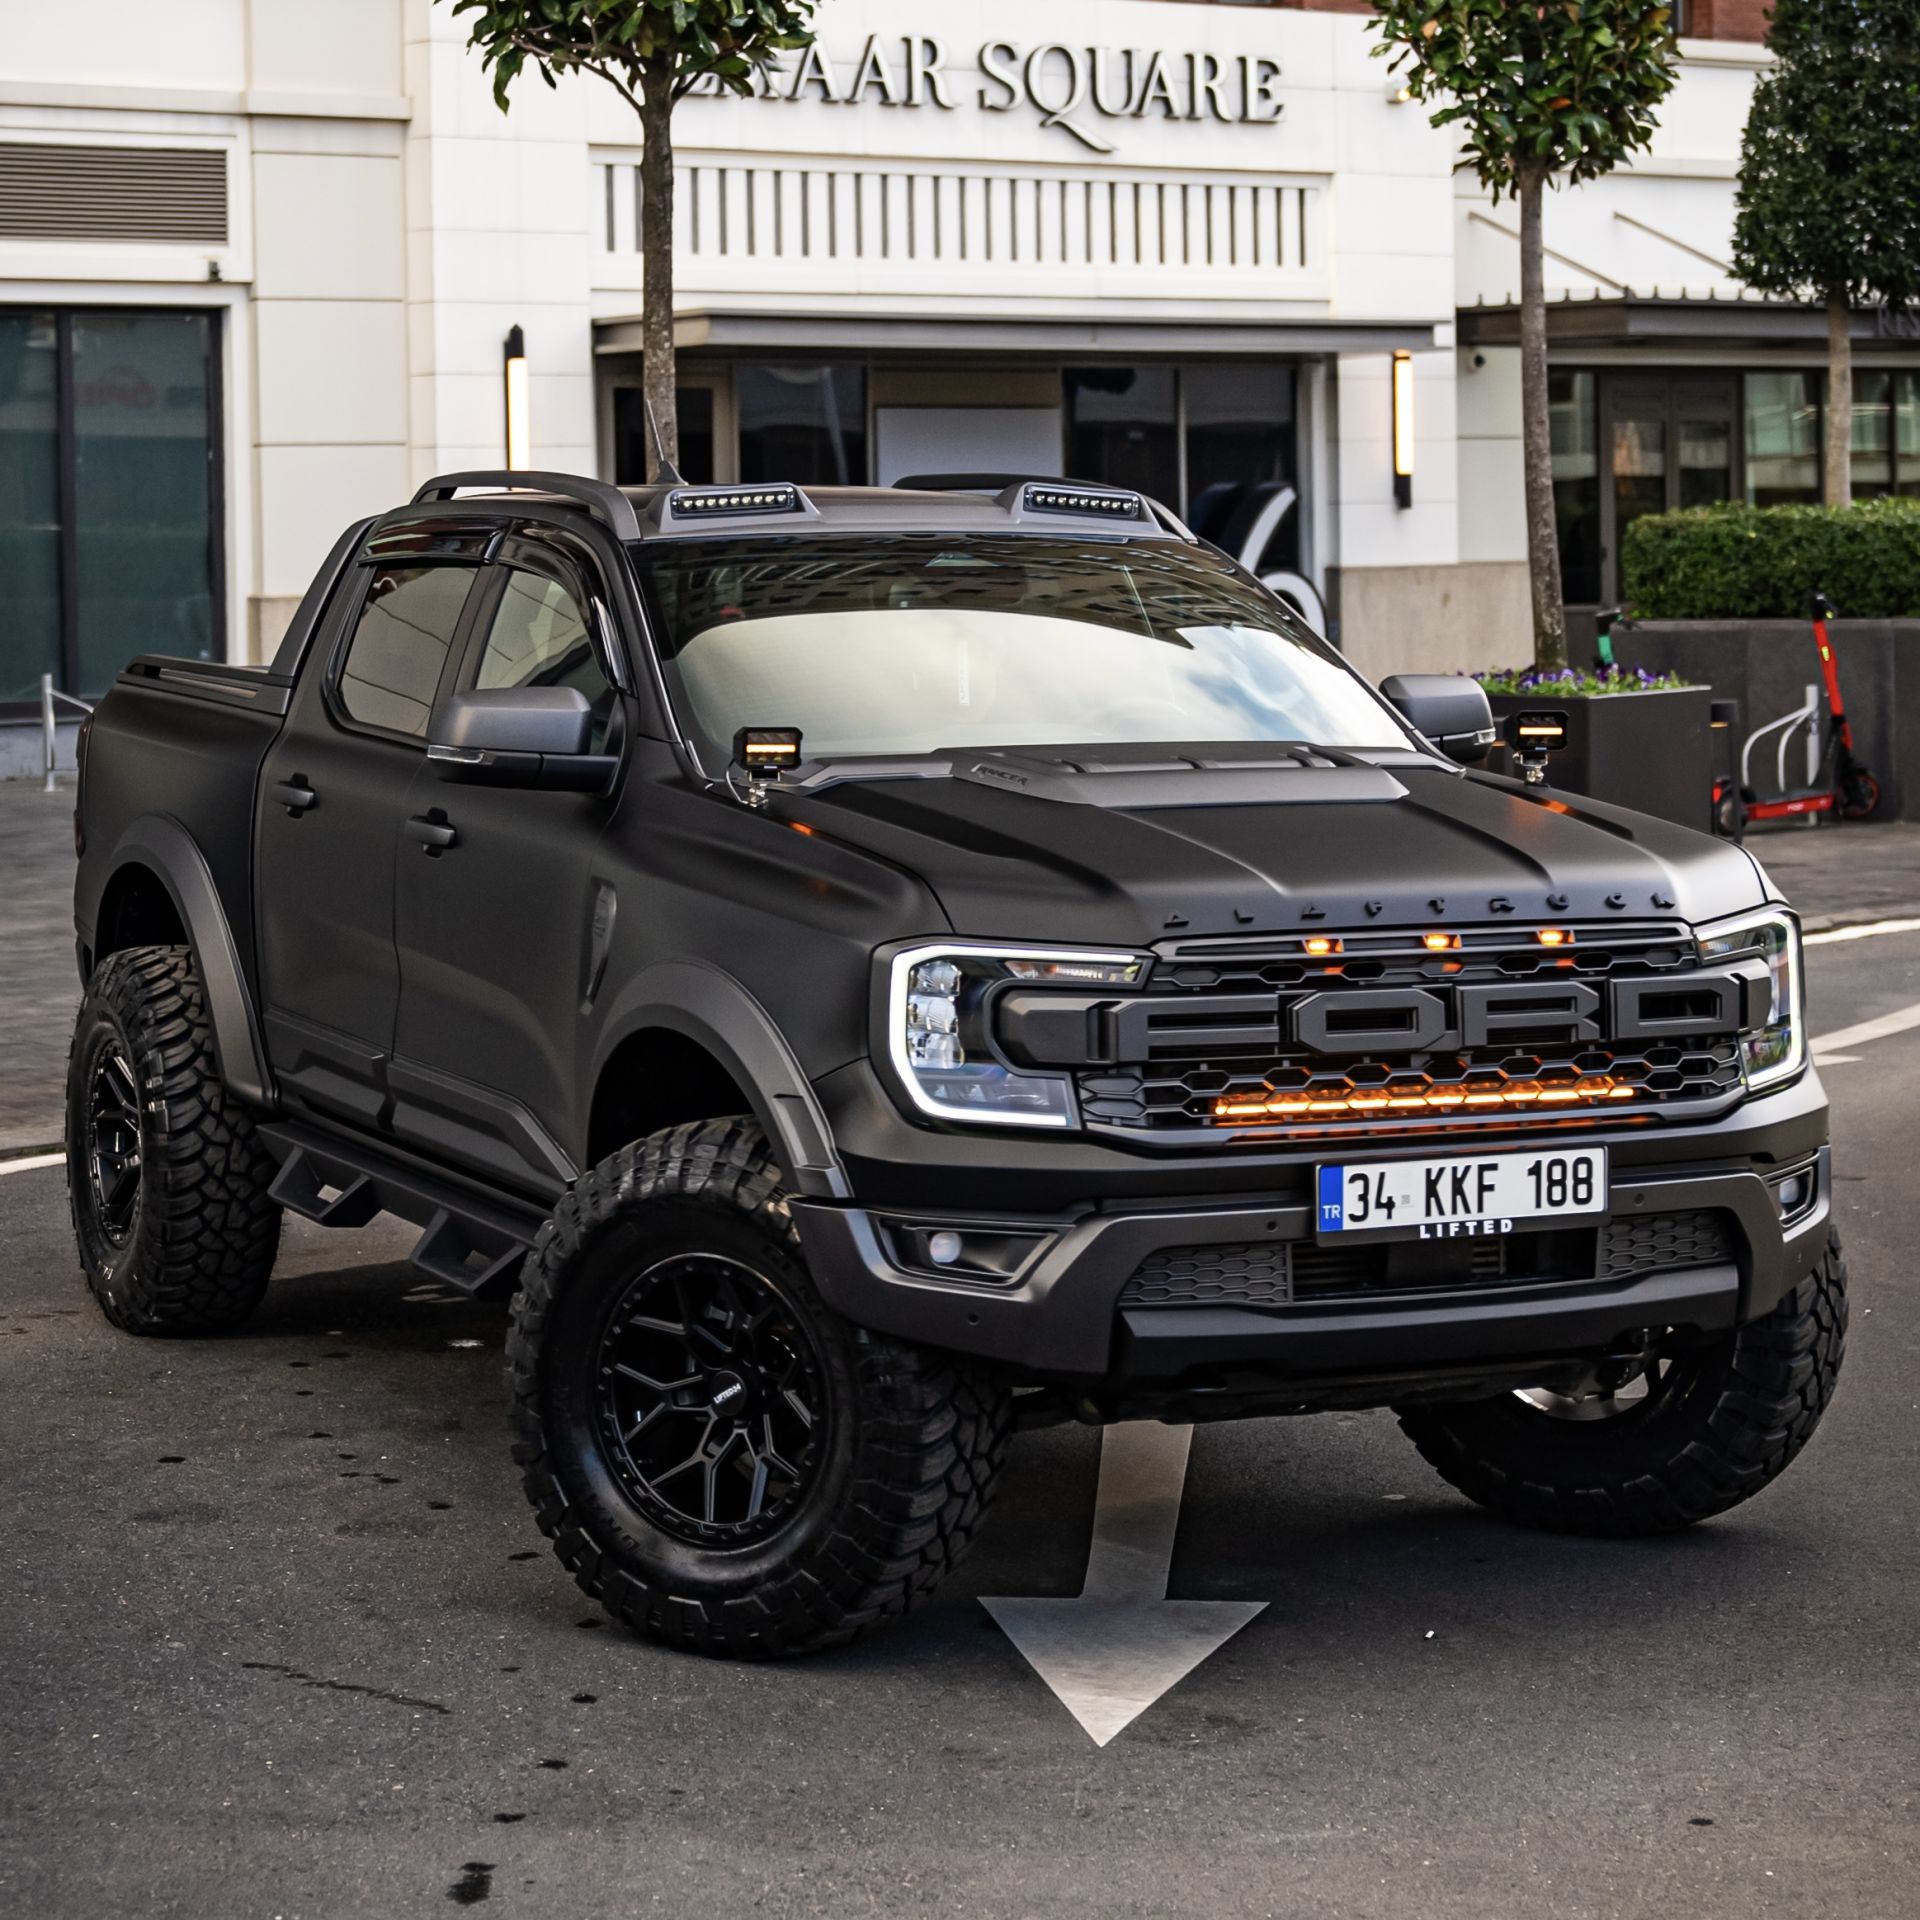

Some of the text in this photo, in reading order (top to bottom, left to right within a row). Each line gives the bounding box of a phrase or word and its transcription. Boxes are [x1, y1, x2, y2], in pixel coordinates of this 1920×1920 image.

[684, 33, 1287, 153] AAR SQUARE
[1106, 972, 1746, 1066] FORD
[1322, 1155, 1594, 1223] TR 34 KKF 188
[1419, 1218, 1513, 1239] LIFTED
